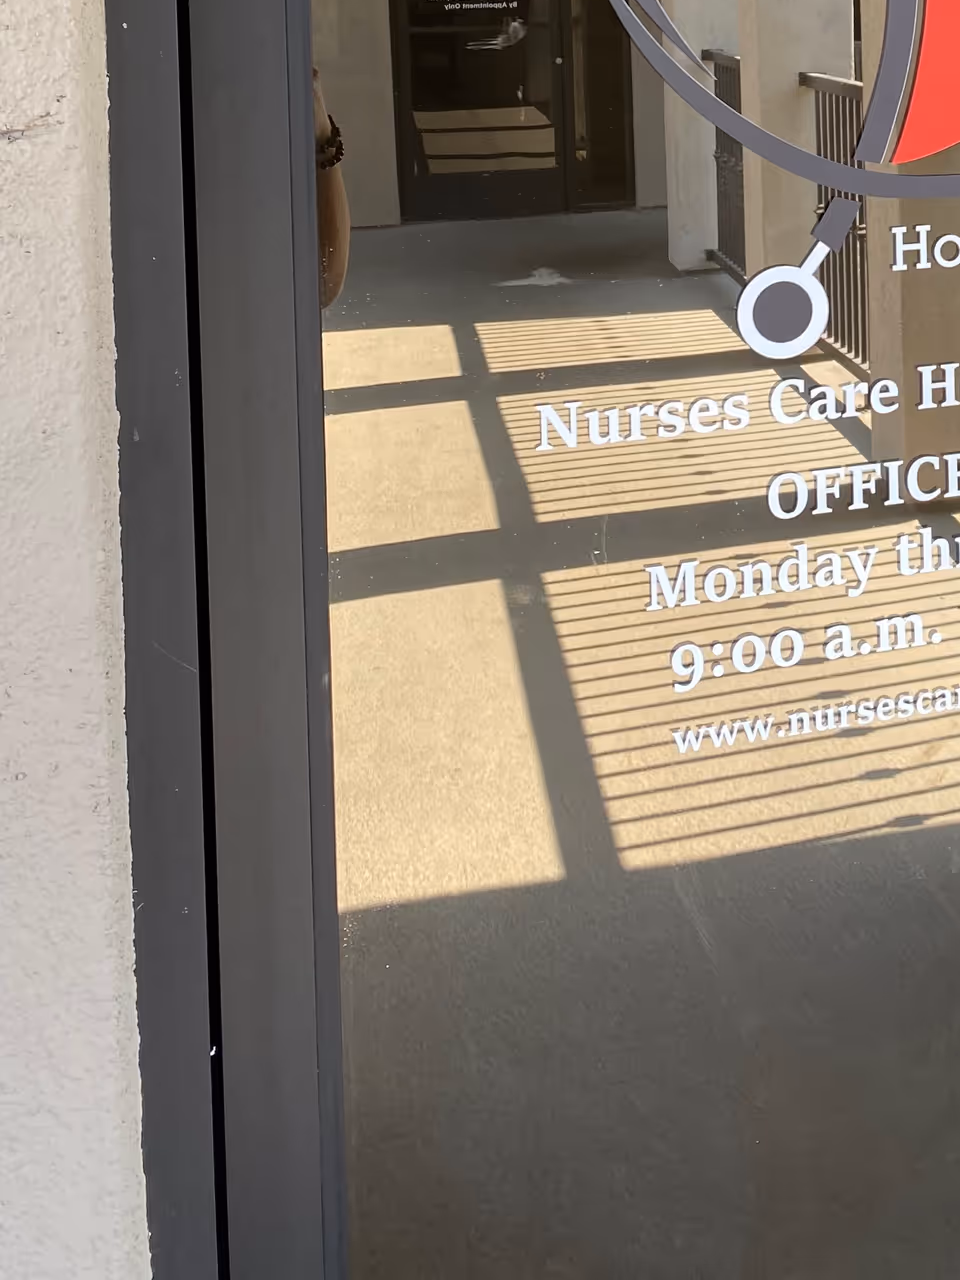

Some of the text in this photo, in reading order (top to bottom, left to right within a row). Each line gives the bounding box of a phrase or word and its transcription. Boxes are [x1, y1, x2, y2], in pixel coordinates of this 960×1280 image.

[535, 393, 751, 452] Nurses
[769, 377, 900, 425] Care
[645, 542, 878, 612] Monday
[671, 627, 805, 693] 9:00
[823, 612, 943, 661] a.m.
